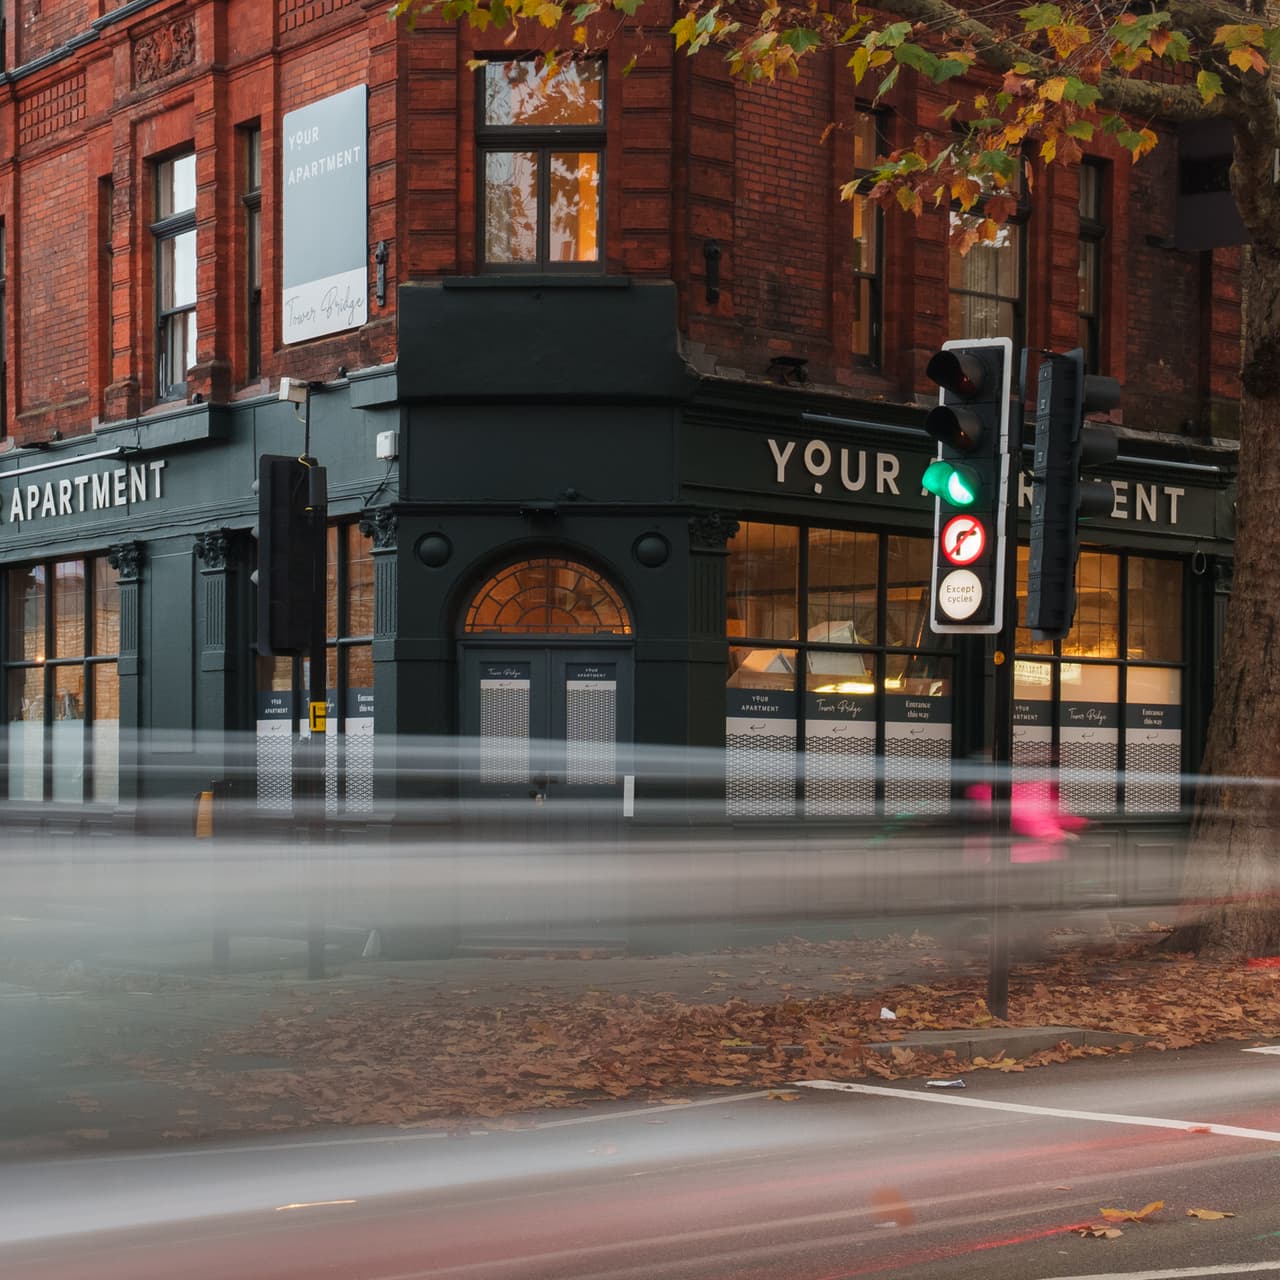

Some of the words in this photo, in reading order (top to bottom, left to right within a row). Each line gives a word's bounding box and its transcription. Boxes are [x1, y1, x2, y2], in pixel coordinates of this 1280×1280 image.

[288, 126, 319, 151] YOUR
[288, 146, 360, 185] APARTMENT
[286, 296, 317, 326] Tower
[320, 286, 364, 326] Bridge
[767, 438, 901, 495] YOUR
[10, 460, 165, 522] APARTMENT
[946, 584, 975, 593] Except
[948, 595, 973, 603] cycles
[752, 695, 769, 703] YOUR
[741, 704, 779, 713] APARTMENT
[905, 700, 931, 709] Entrance
[907, 711, 919, 719] this
[919, 712, 929, 720] way
[1142, 708, 1164, 717] Entrance
